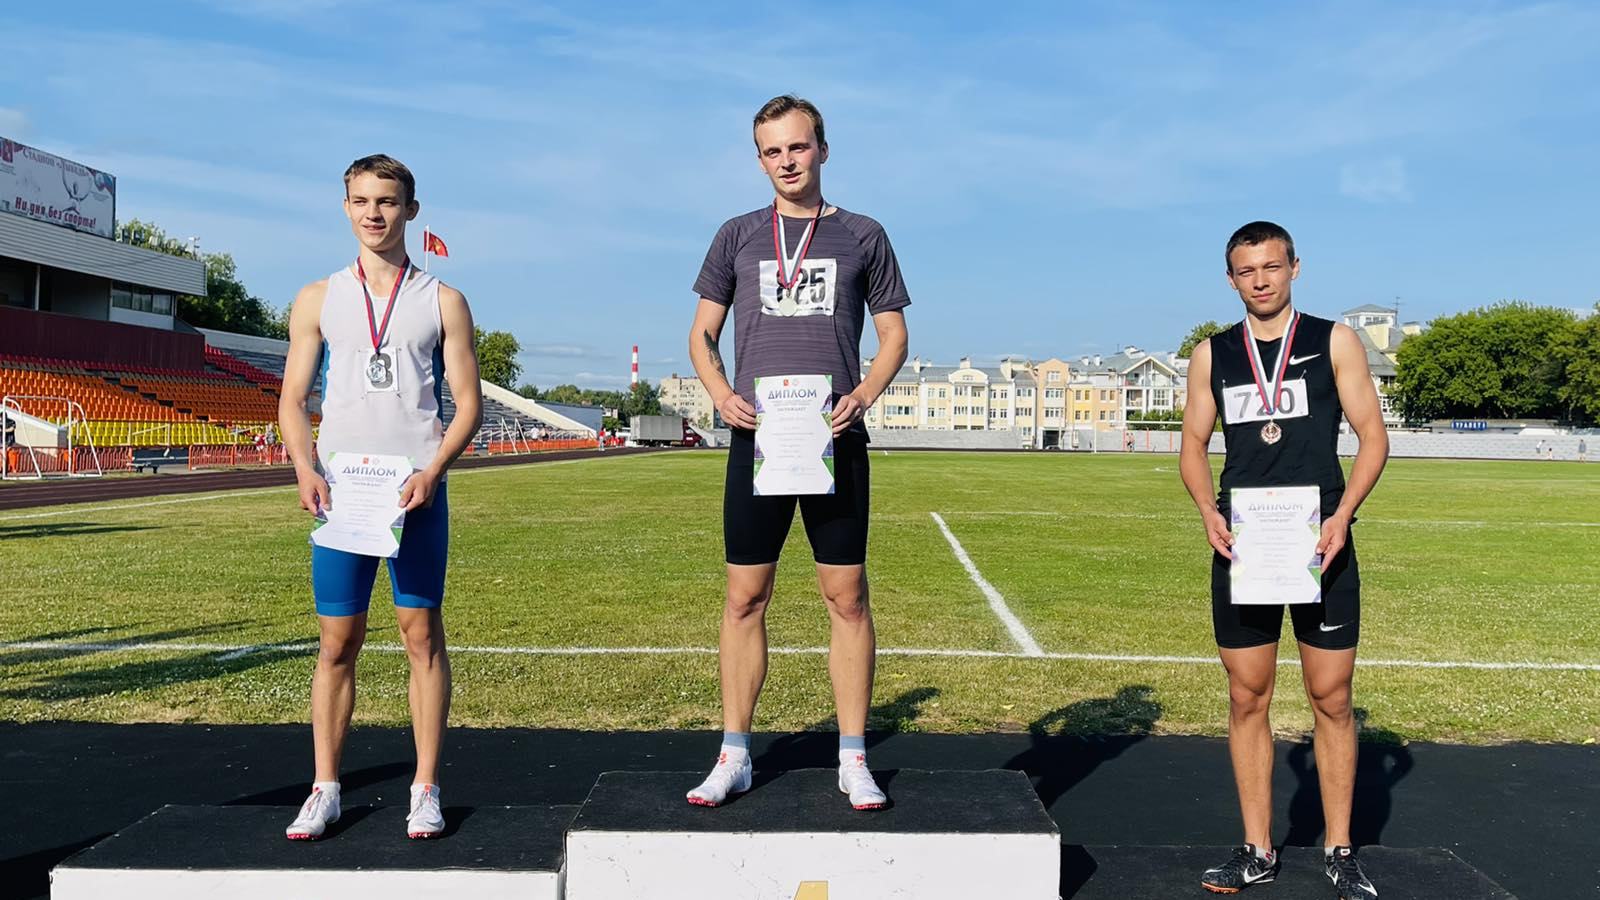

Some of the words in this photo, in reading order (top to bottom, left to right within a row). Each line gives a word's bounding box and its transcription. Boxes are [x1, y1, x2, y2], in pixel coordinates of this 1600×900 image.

[48, 206, 62, 220] без
[768, 389, 817, 400] ДИПЛОМ
[342, 465, 397, 477] ДИПЛОМ
[1248, 503, 1304, 511] ДИПЛОМ
